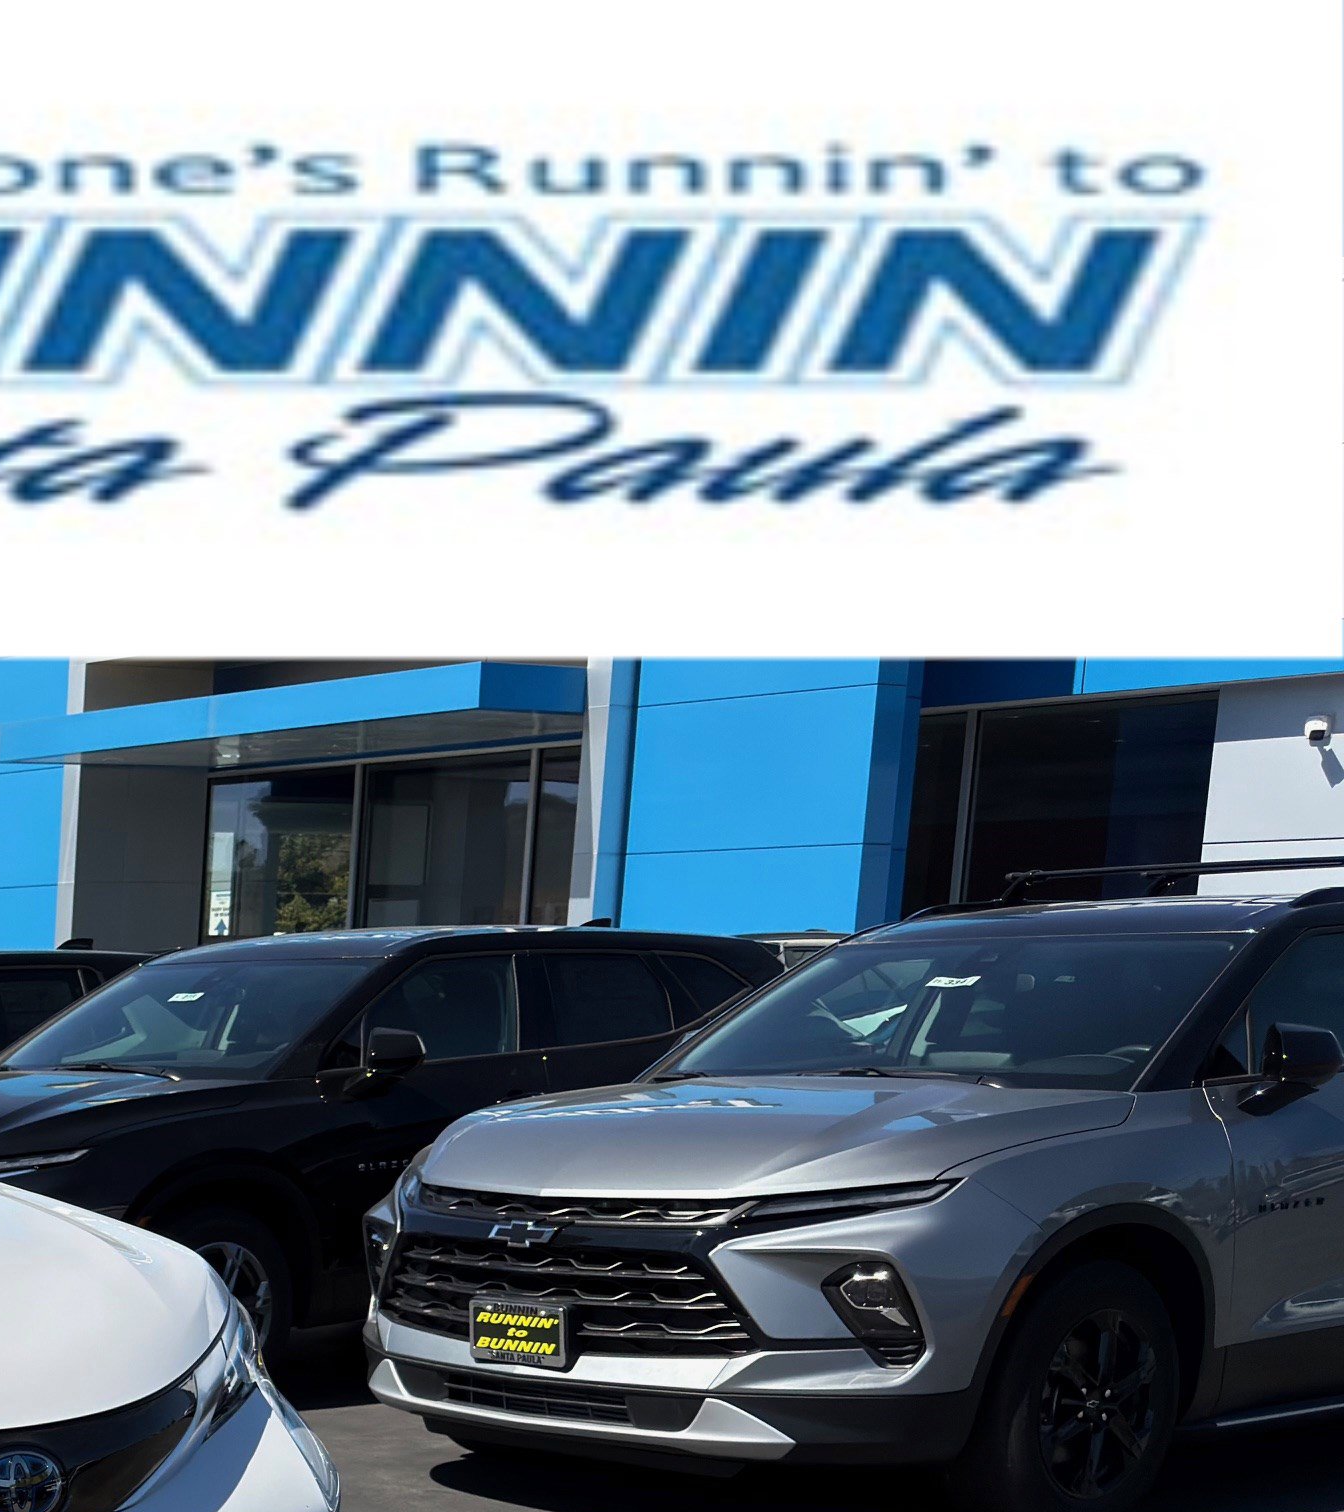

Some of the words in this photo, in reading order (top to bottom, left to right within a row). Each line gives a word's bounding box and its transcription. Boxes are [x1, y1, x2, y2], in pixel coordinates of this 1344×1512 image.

[476, 1311, 559, 1329] RUNNIN'
[506, 1327, 529, 1338] to
[476, 1336, 556, 1355] BUNNIN
